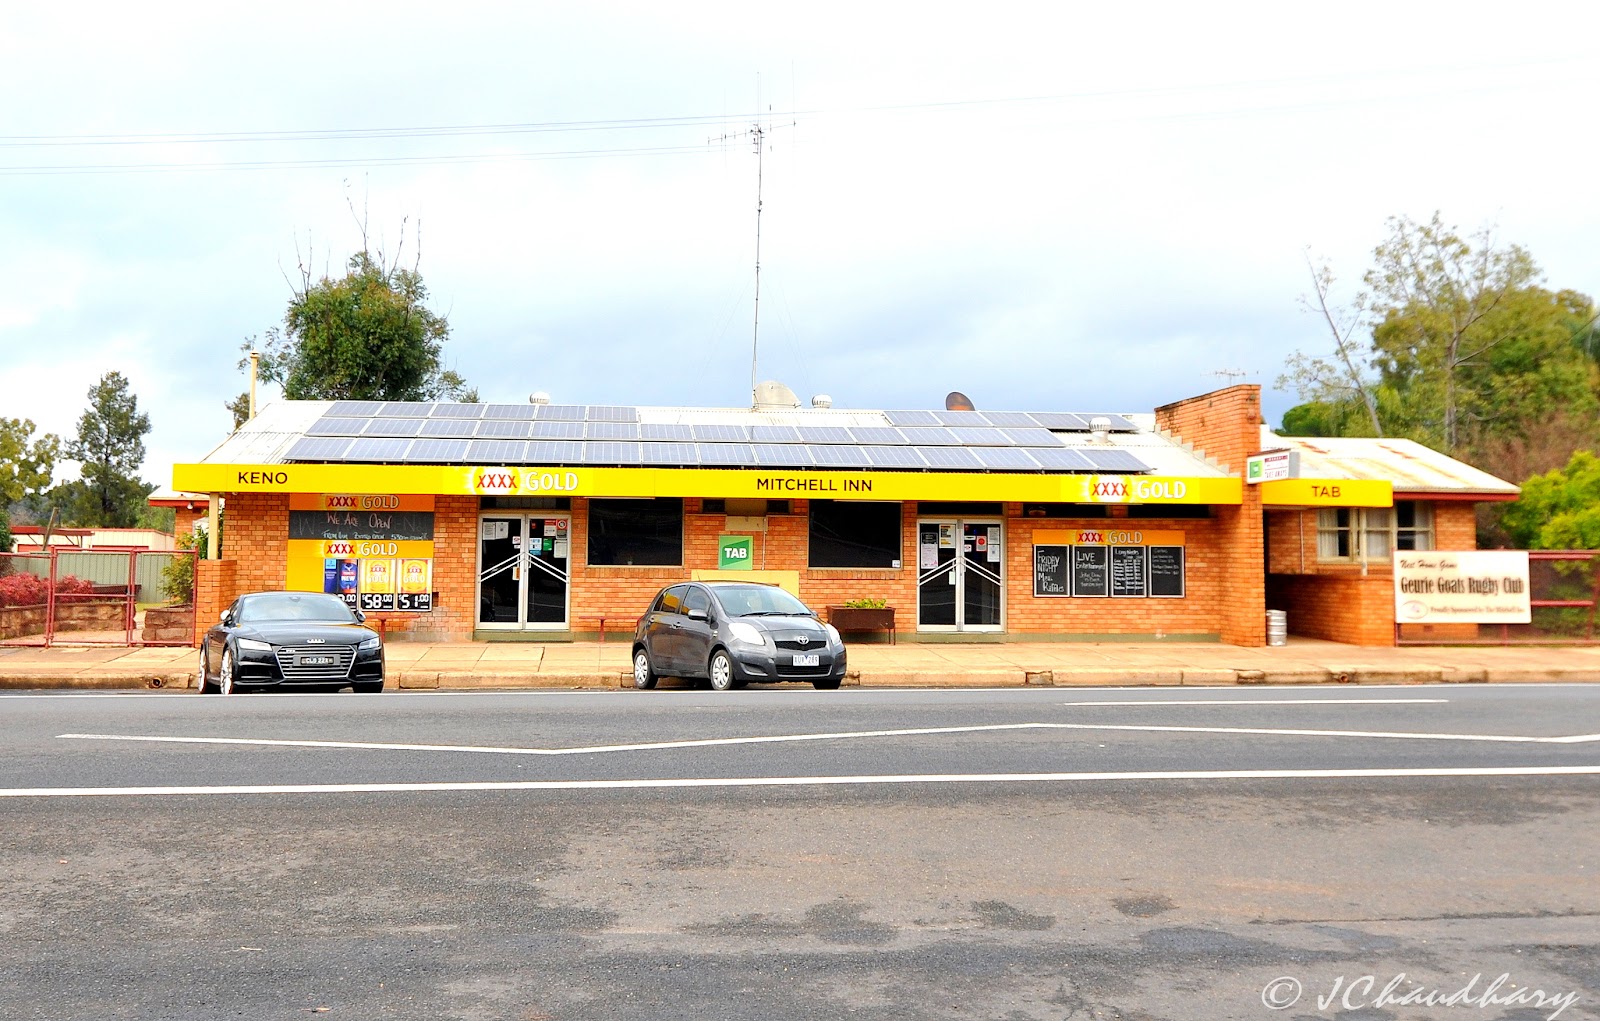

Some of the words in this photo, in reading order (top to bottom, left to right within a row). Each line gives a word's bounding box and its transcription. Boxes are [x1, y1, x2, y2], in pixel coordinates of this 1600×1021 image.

[238, 471, 288, 484] KENO
[477, 474, 517, 488] XXXX
[525, 472, 579, 490] GOLD
[757, 479, 837, 491] MITCHELL
[843, 479, 872, 491] INN
[1092, 482, 1129, 496] XXXX
[1137, 480, 1186, 498] GOLD
[1312, 485, 1341, 497] TAB
[328, 497, 357, 507] XXXX
[362, 495, 399, 509] GOLD
[369, 513, 392, 529] OPEN
[1078, 533, 1104, 543] XXXX
[1109, 531, 1143, 544] GOLD
[326, 543, 356, 555] XXXX
[360, 542, 398, 556] GOLD
[724, 548, 747, 558] TAB
[1401, 577, 1434, 593] Geurie
[1437, 577, 1465, 593] Goats
[1468, 577, 1499, 596] Rugby
[1503, 577, 1524, 593] Club
